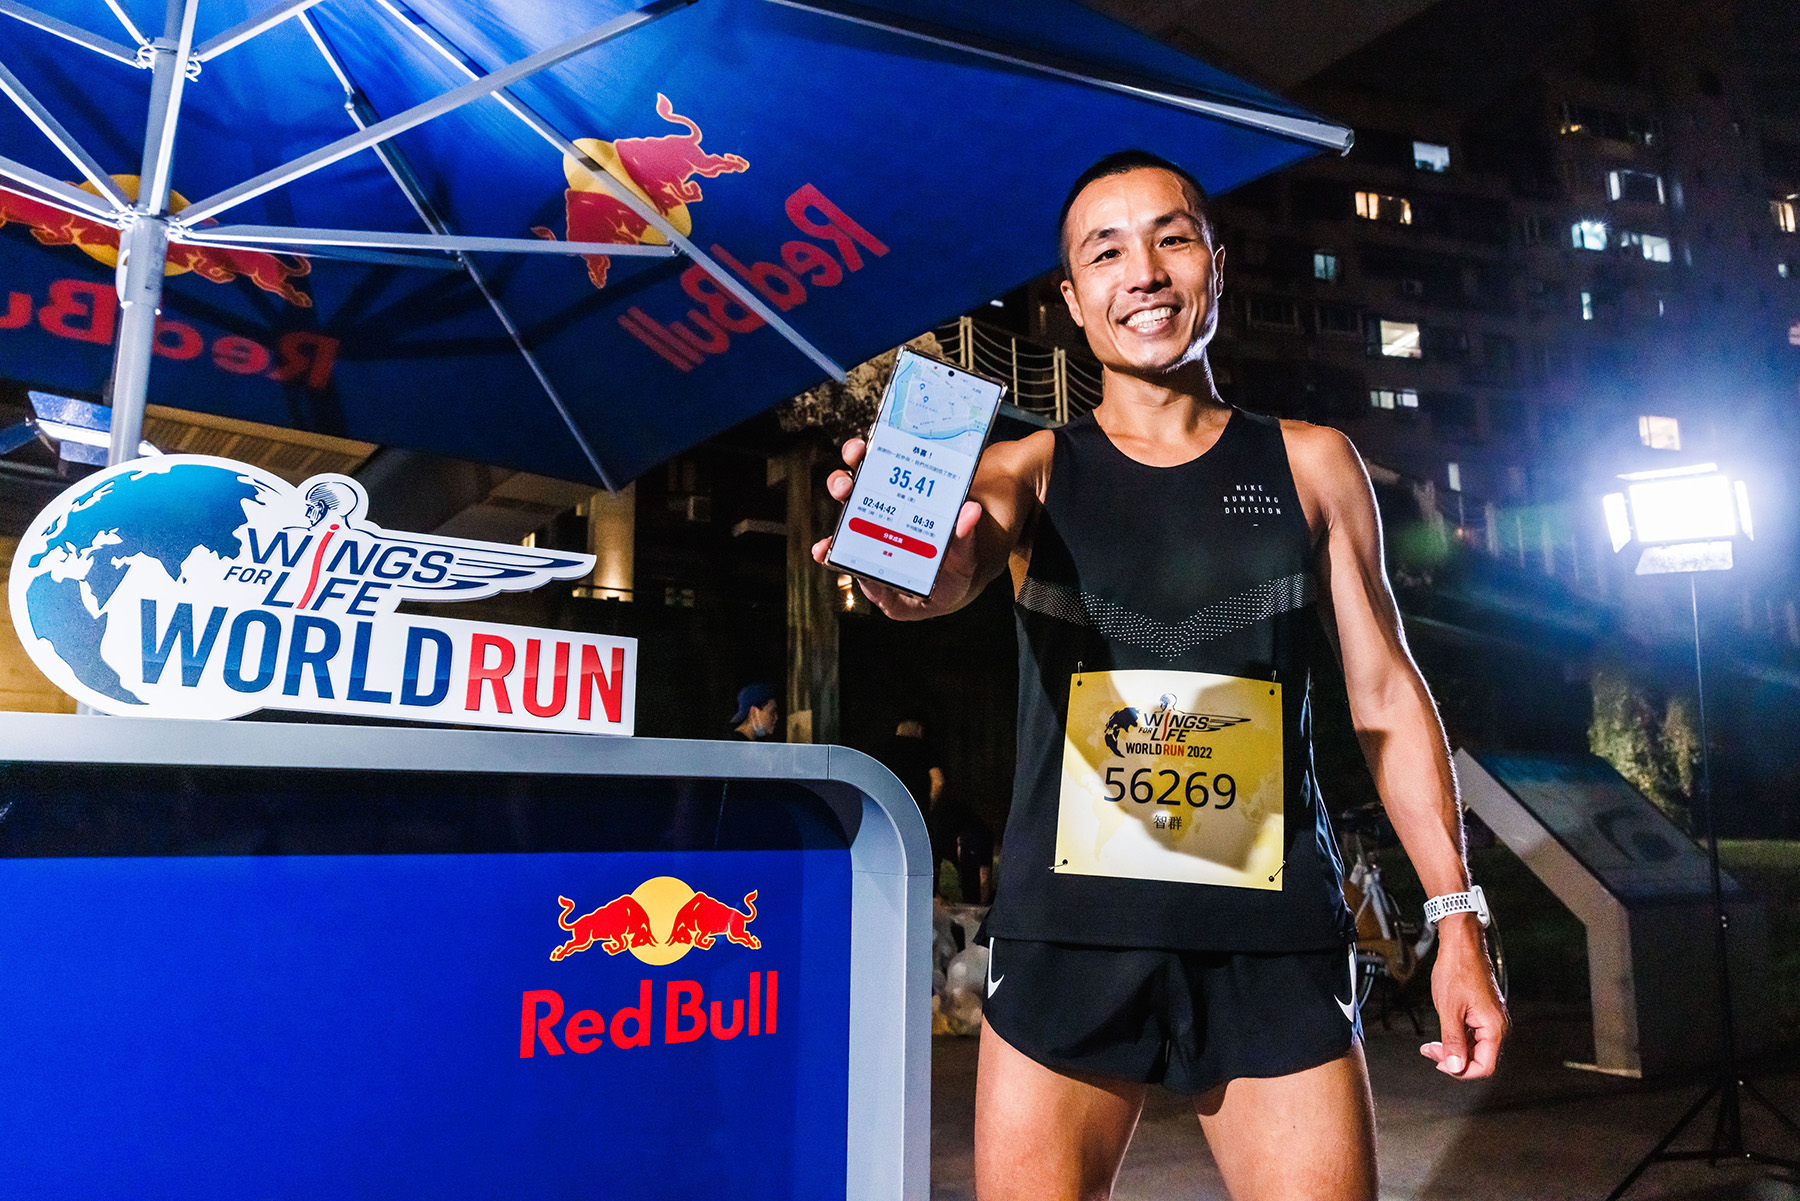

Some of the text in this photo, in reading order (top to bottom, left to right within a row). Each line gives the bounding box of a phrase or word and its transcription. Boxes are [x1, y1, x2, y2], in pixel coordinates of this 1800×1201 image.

[889, 466, 936, 498] 35.41
[1236, 484, 1263, 492] NIKE
[862, 496, 897, 516] 02:44:42
[1224, 507, 1281, 515] DIVISION
[912, 514, 935, 530] 04:39
[224, 565, 271, 586] FOR
[140, 598, 625, 724] WORLD RUN
[1125, 743, 1213, 759] WORLD RUN 2022
[1104, 767, 1237, 810] 56269
[1153, 815, 1183, 831] 智群
[519, 970, 778, 1059] Red Bull
